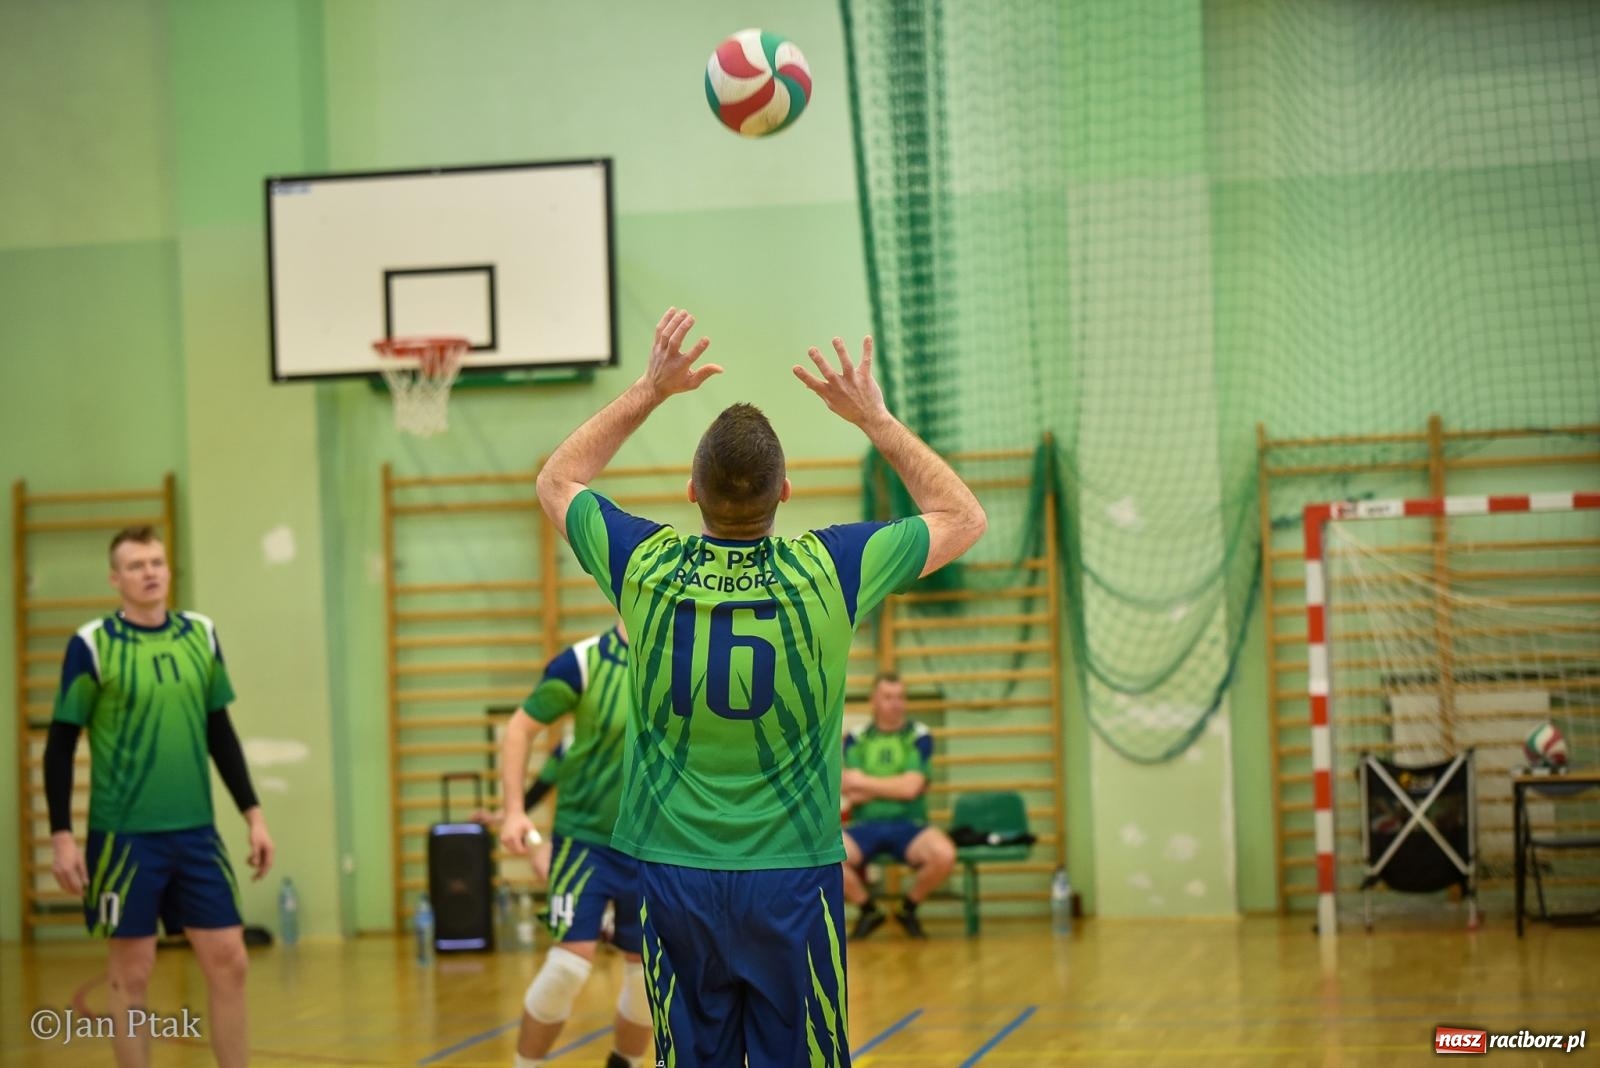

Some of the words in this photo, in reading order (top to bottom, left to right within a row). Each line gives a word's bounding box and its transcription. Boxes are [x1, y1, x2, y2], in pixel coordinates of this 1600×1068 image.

[684, 548, 716, 567] KP
[726, 549, 769, 570] PSP
[673, 567, 779, 593] RACIBÓRZ
[153, 652, 181, 684] 17
[671, 597, 778, 720] 16
[550, 891, 575, 929] 14
